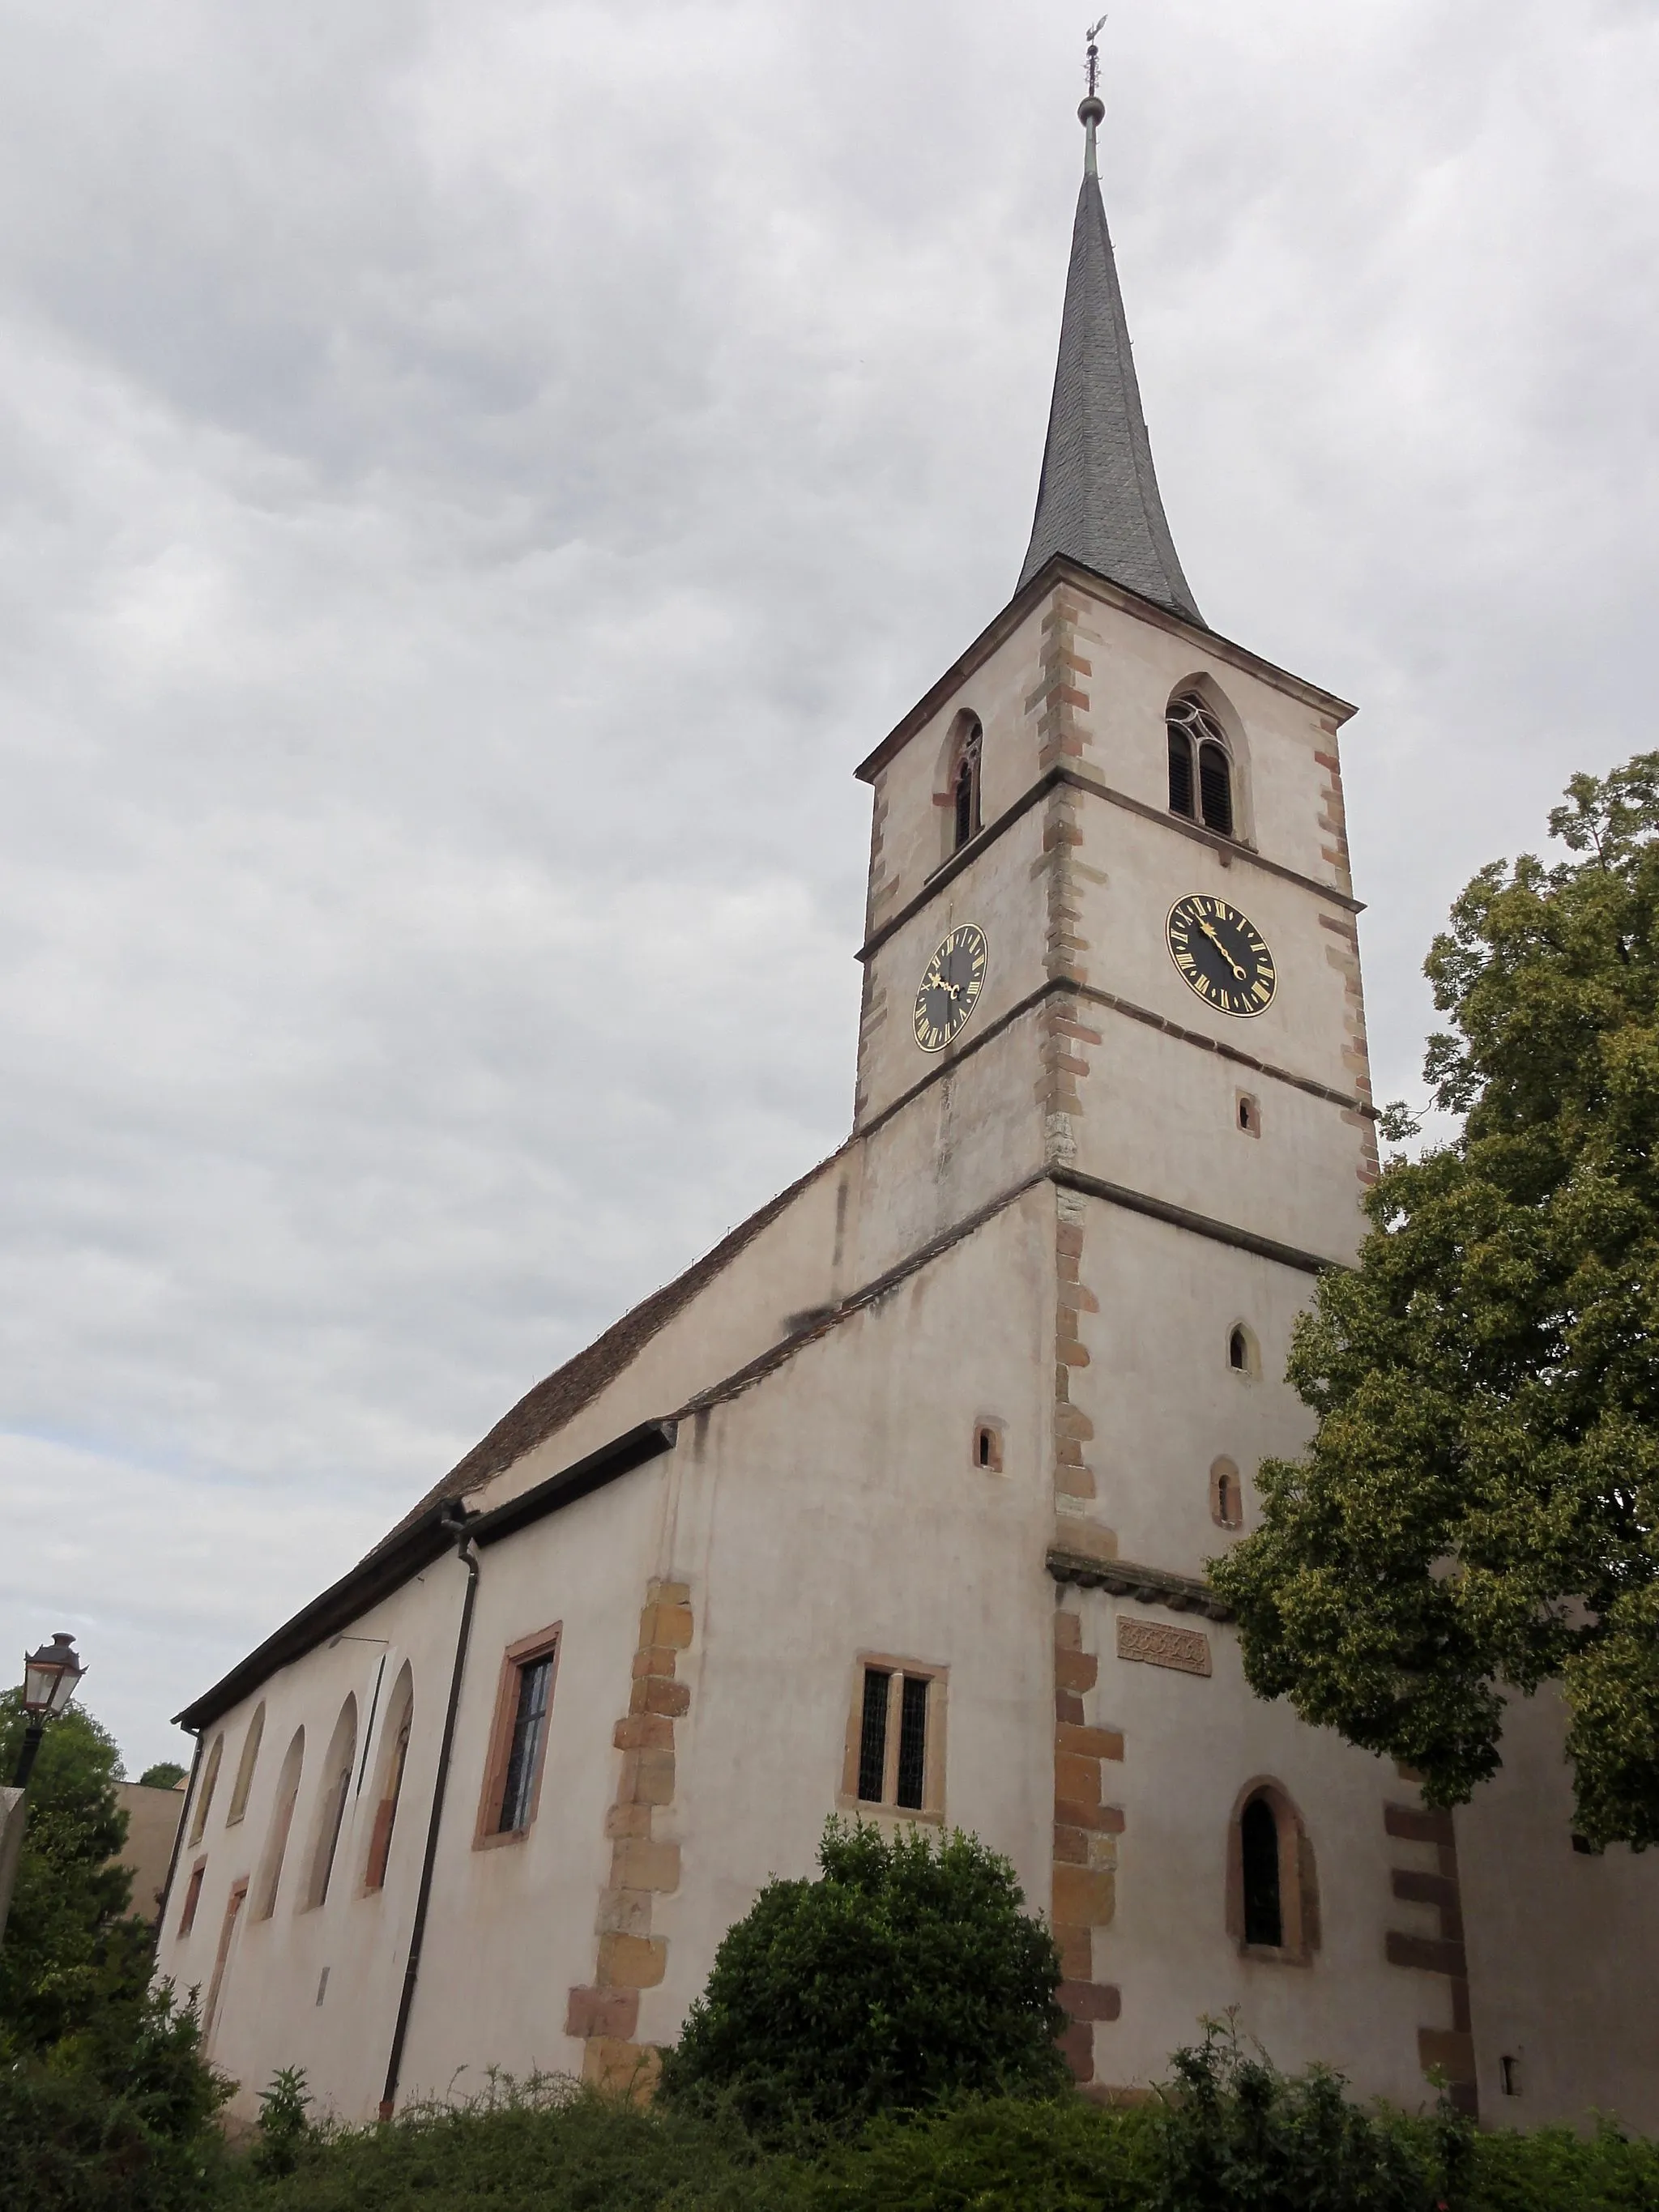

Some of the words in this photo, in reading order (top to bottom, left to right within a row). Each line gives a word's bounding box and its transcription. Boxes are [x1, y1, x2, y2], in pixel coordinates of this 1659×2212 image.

[1175, 906, 1193, 925] X
[1236, 918, 1247, 931] I
[1250, 943, 1266, 952] II
[1257, 965, 1273, 979] III
[1221, 989, 1230, 1009] VI
[1252, 981, 1270, 1003] IIII
[1242, 992, 1253, 1012] V
